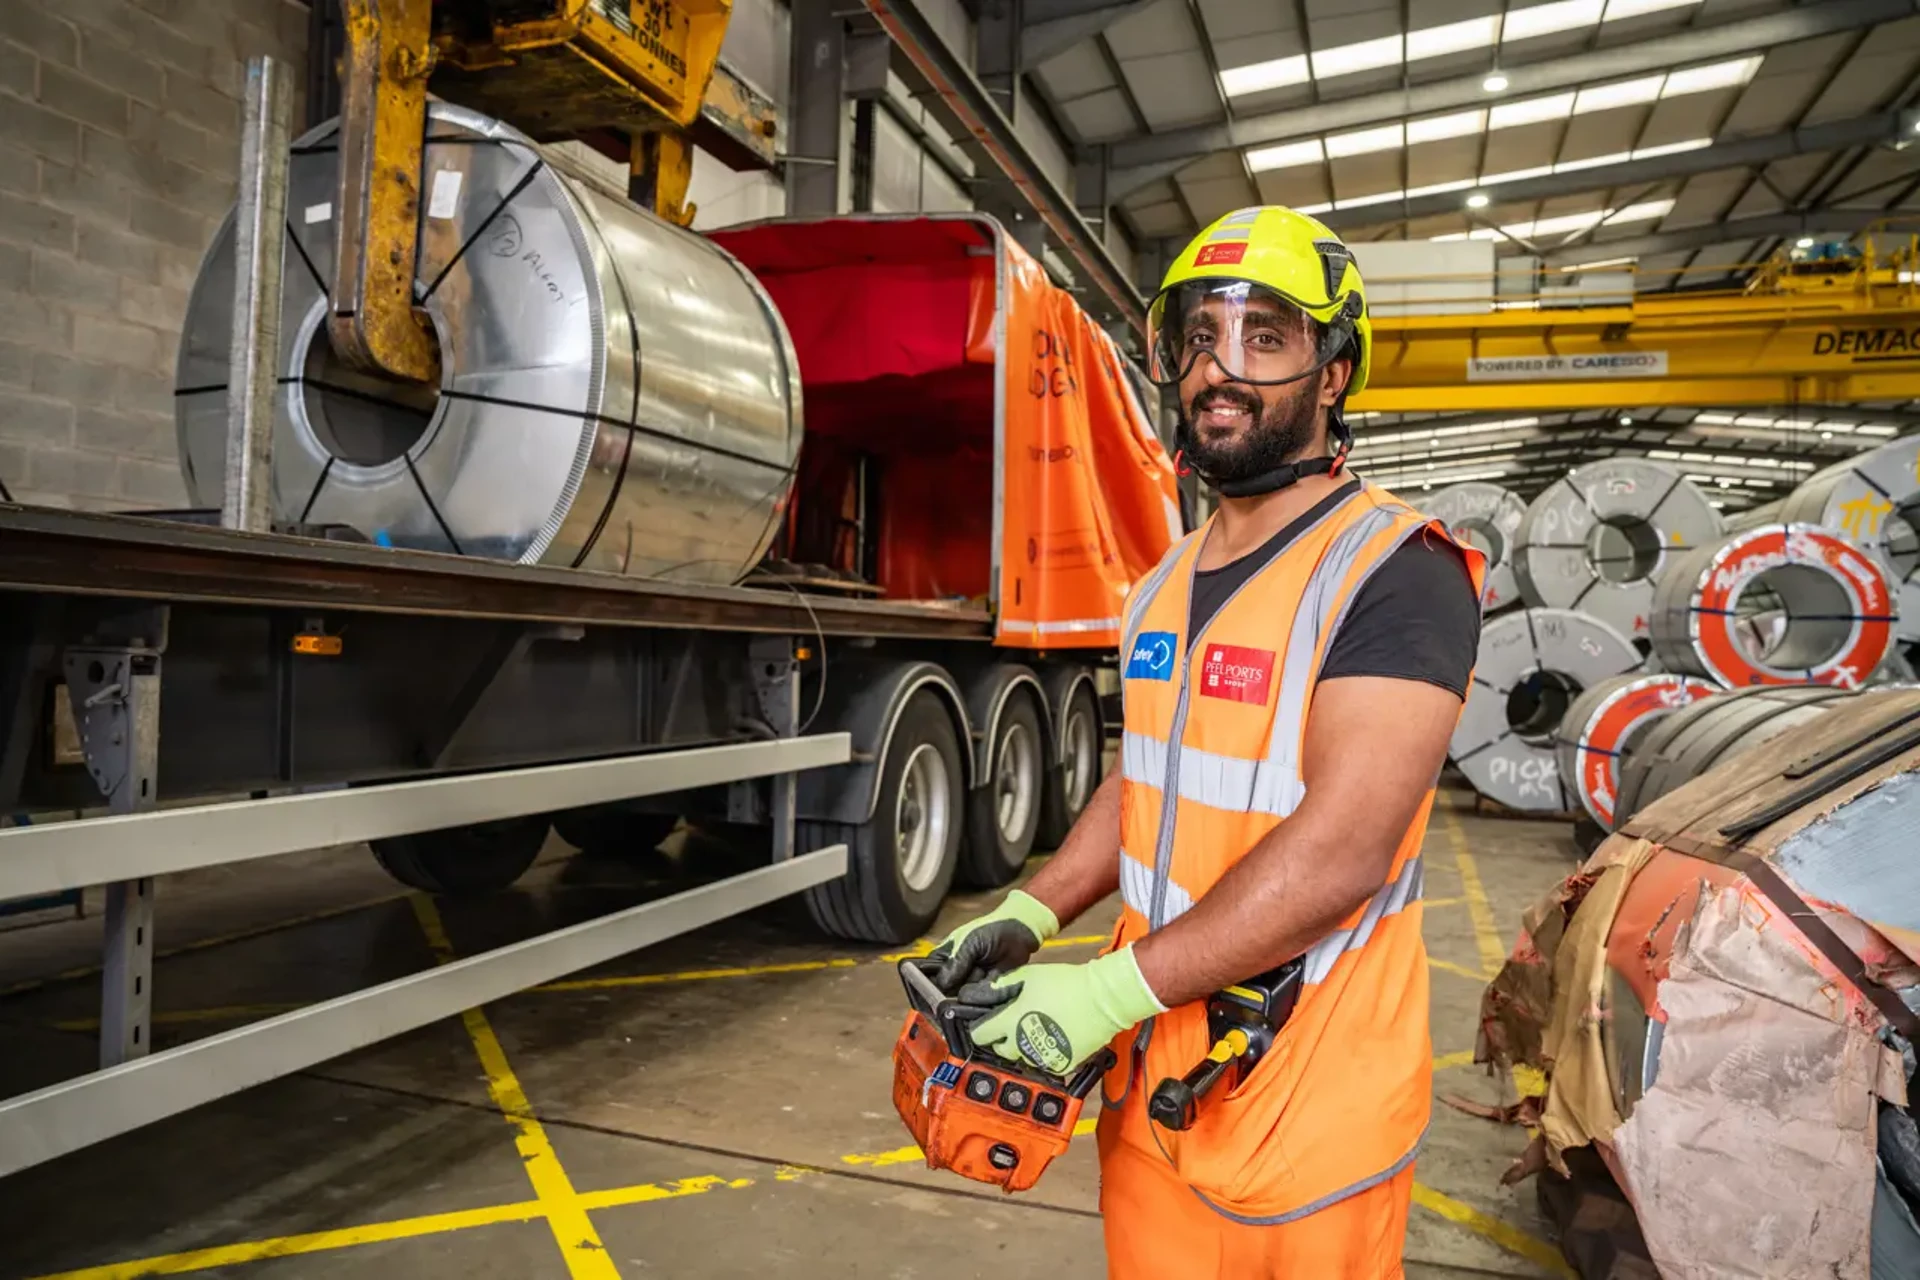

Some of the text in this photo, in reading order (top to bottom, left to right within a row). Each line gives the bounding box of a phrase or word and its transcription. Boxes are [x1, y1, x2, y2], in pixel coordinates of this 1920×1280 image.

[637, 0, 672, 29] WL
[644, 12, 660, 37] 30
[630, 23, 687, 78] TONNES
[1475, 360, 1544, 372] POWERED
[1543, 485, 1601, 545] PICK
[1205, 661, 1264, 681] PEEL PORTS
[1490, 756, 1557, 785] PICK
